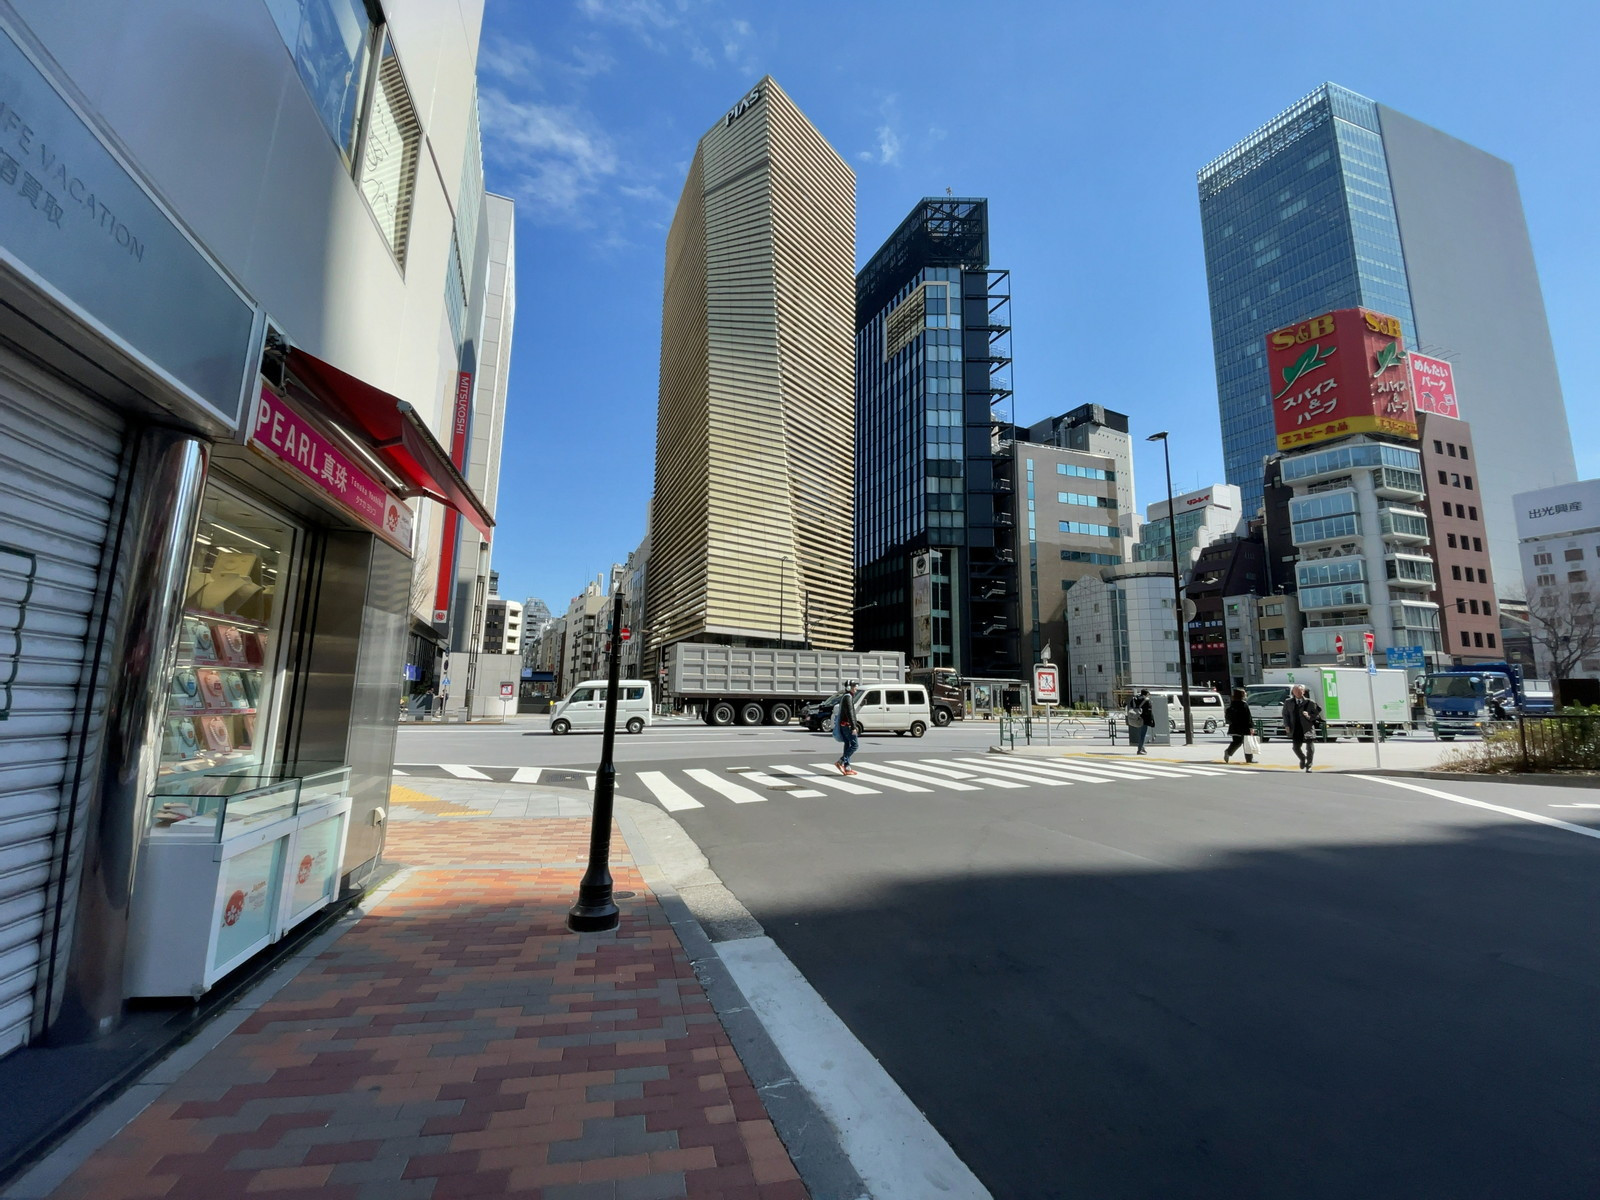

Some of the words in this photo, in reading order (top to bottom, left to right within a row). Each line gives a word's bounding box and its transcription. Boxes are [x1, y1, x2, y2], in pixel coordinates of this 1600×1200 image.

[725, 87, 760, 126] PIAS
[40, 143, 145, 263] VACATION
[1271, 314, 1336, 351] S&B
[1364, 311, 1401, 339] S&B
[1413, 359, 1449, 377] めんたい
[455, 376, 469, 435] MITSUKOSHI
[1308, 398, 1321, 410] &
[256, 398, 319, 474] PEARL
[320, 452, 348, 493] 真珠
[1528, 501, 1583, 519] 出光興産
